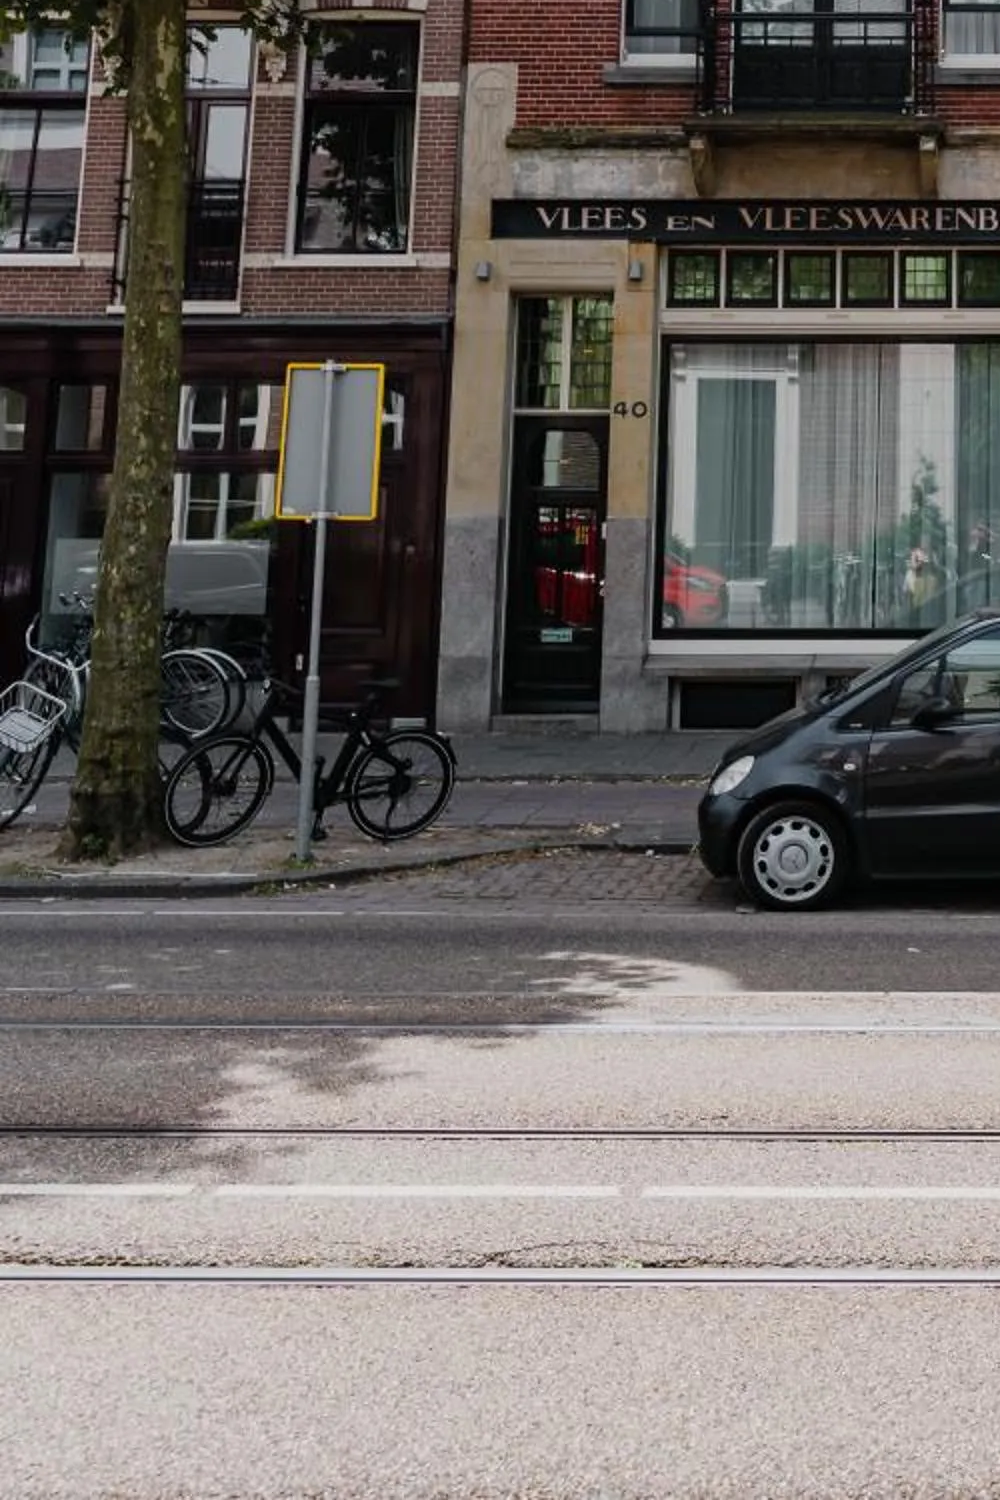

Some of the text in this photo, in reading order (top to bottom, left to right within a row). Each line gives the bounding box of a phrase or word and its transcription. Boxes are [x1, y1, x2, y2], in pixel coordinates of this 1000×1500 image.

[536, 207, 648, 231] VLEES
[665, 215, 716, 231] EN
[613, 401, 647, 418] 40
